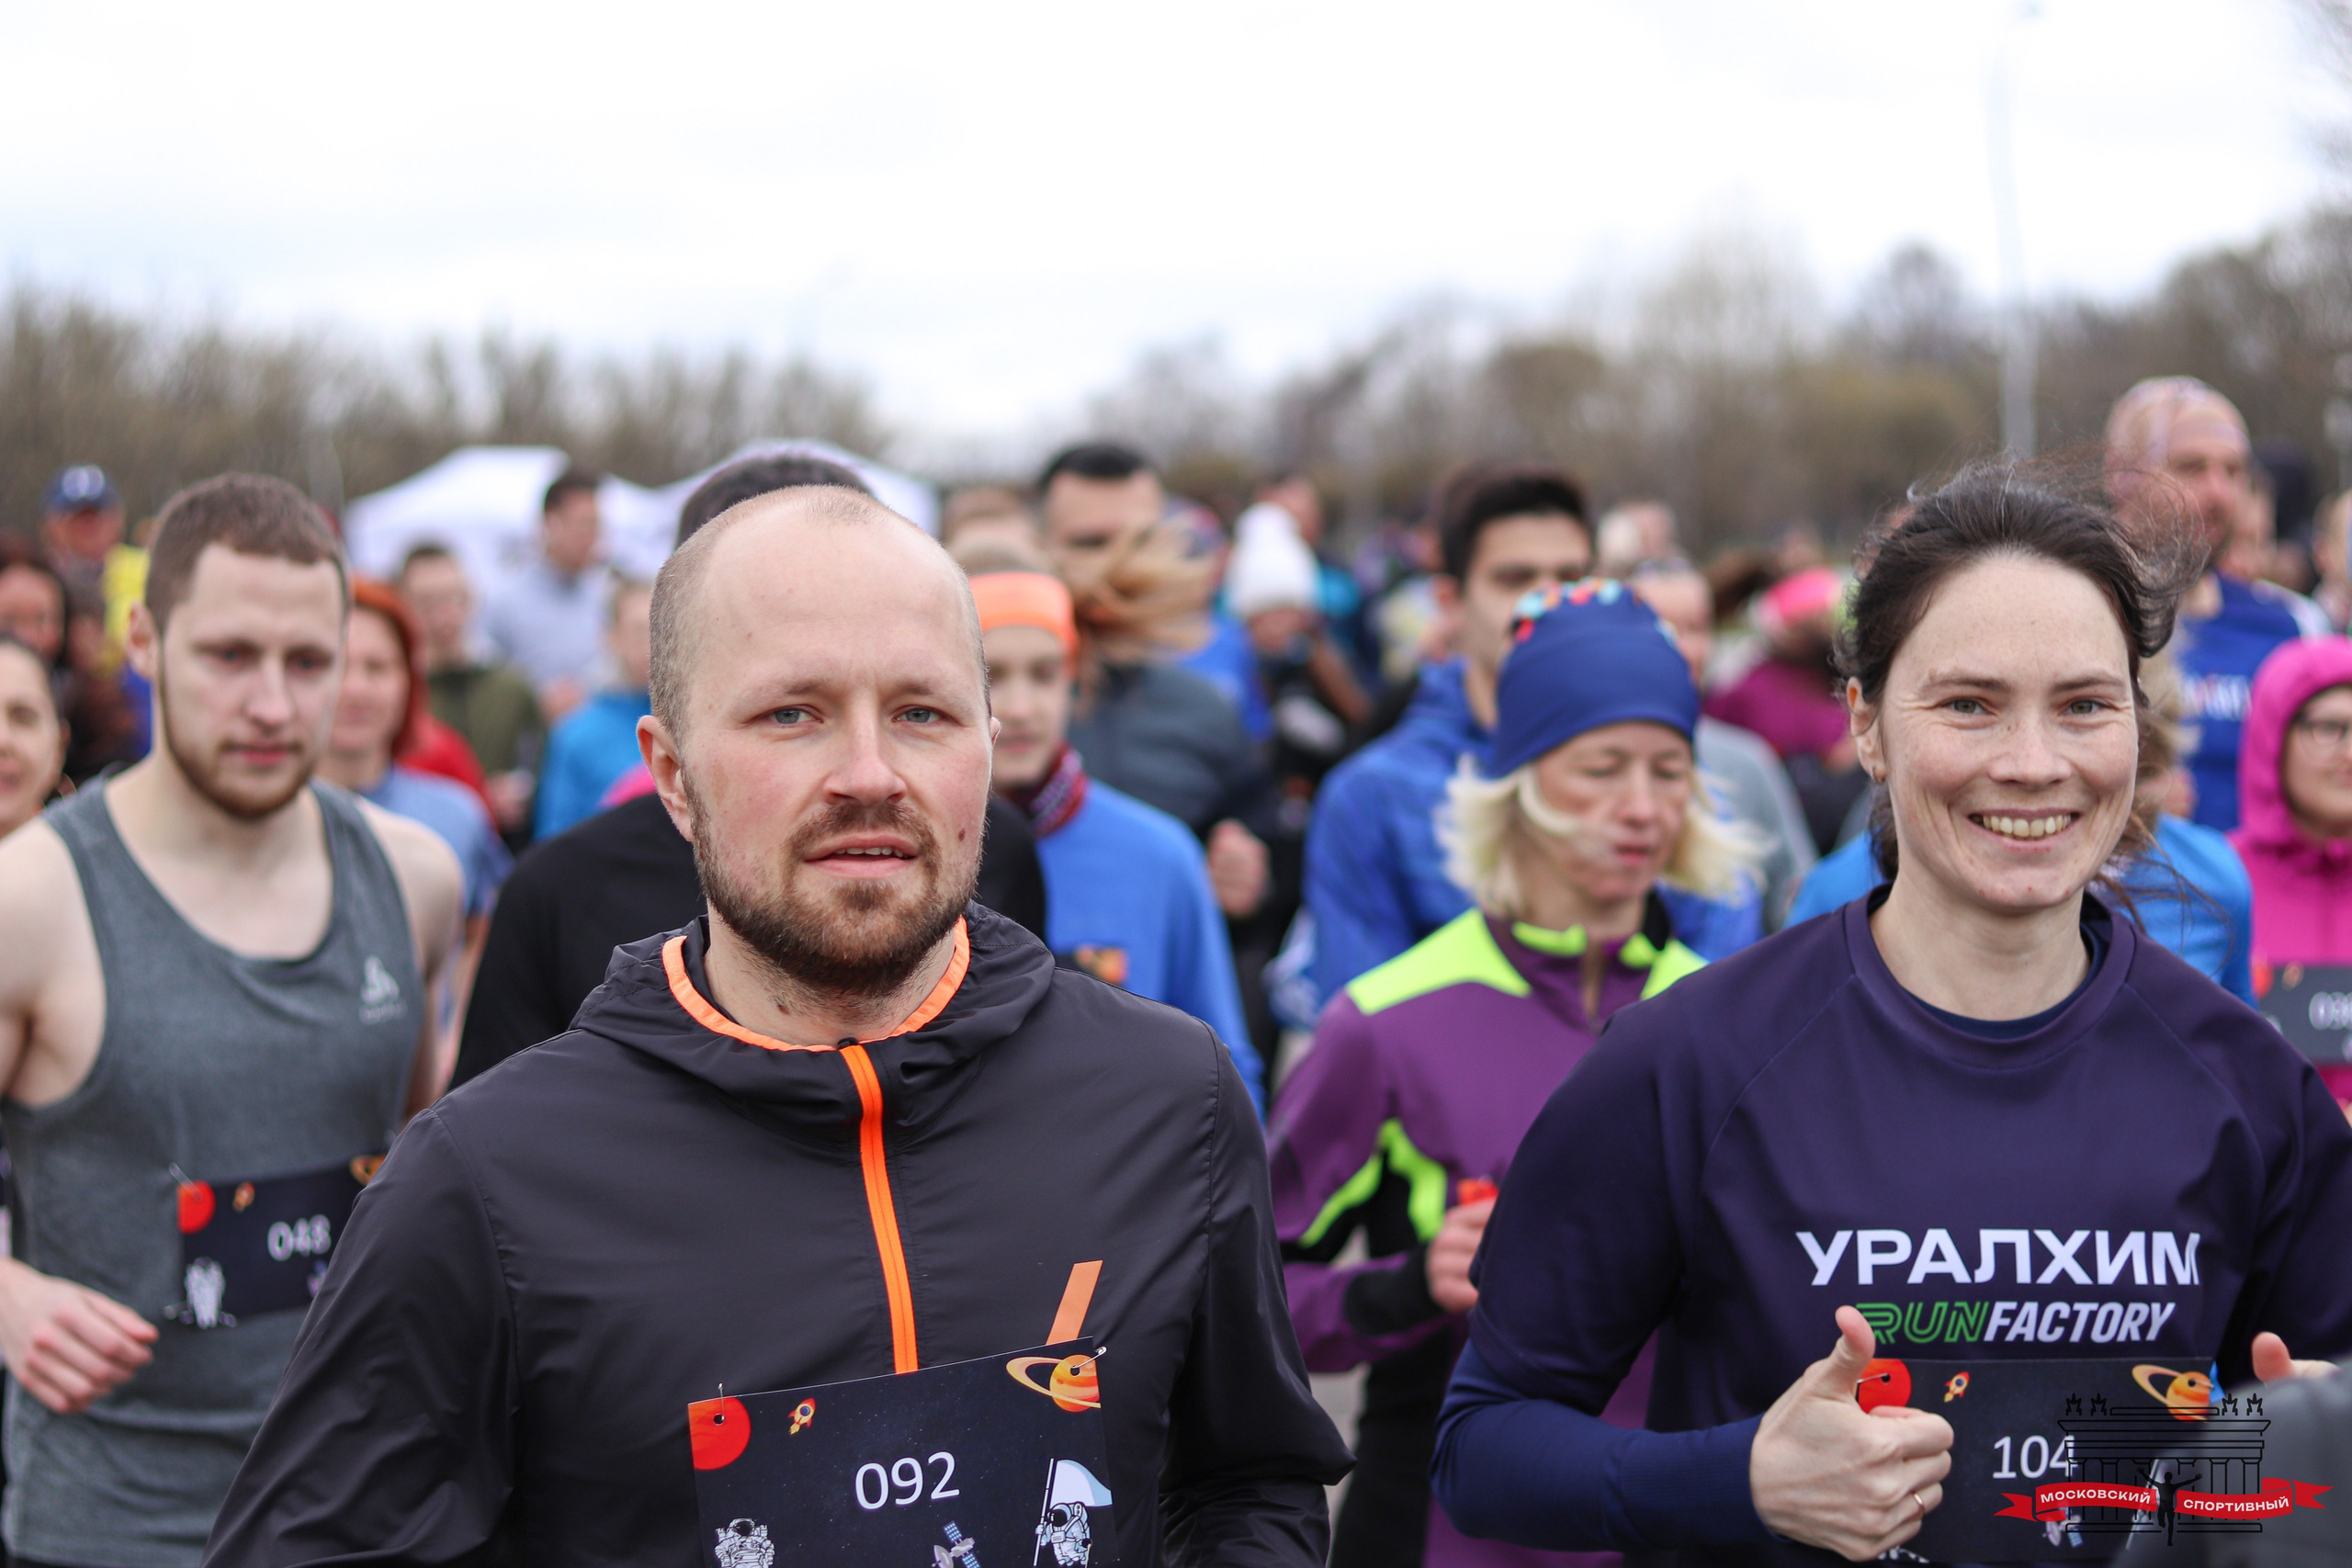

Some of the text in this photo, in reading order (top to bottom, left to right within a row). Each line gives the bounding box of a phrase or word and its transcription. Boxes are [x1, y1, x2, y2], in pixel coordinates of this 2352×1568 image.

[1795, 1228, 2200, 1286] УРАЛХИМ
[855, 1451, 960, 1509] 092
[1992, 1435, 2078, 1479] 104
